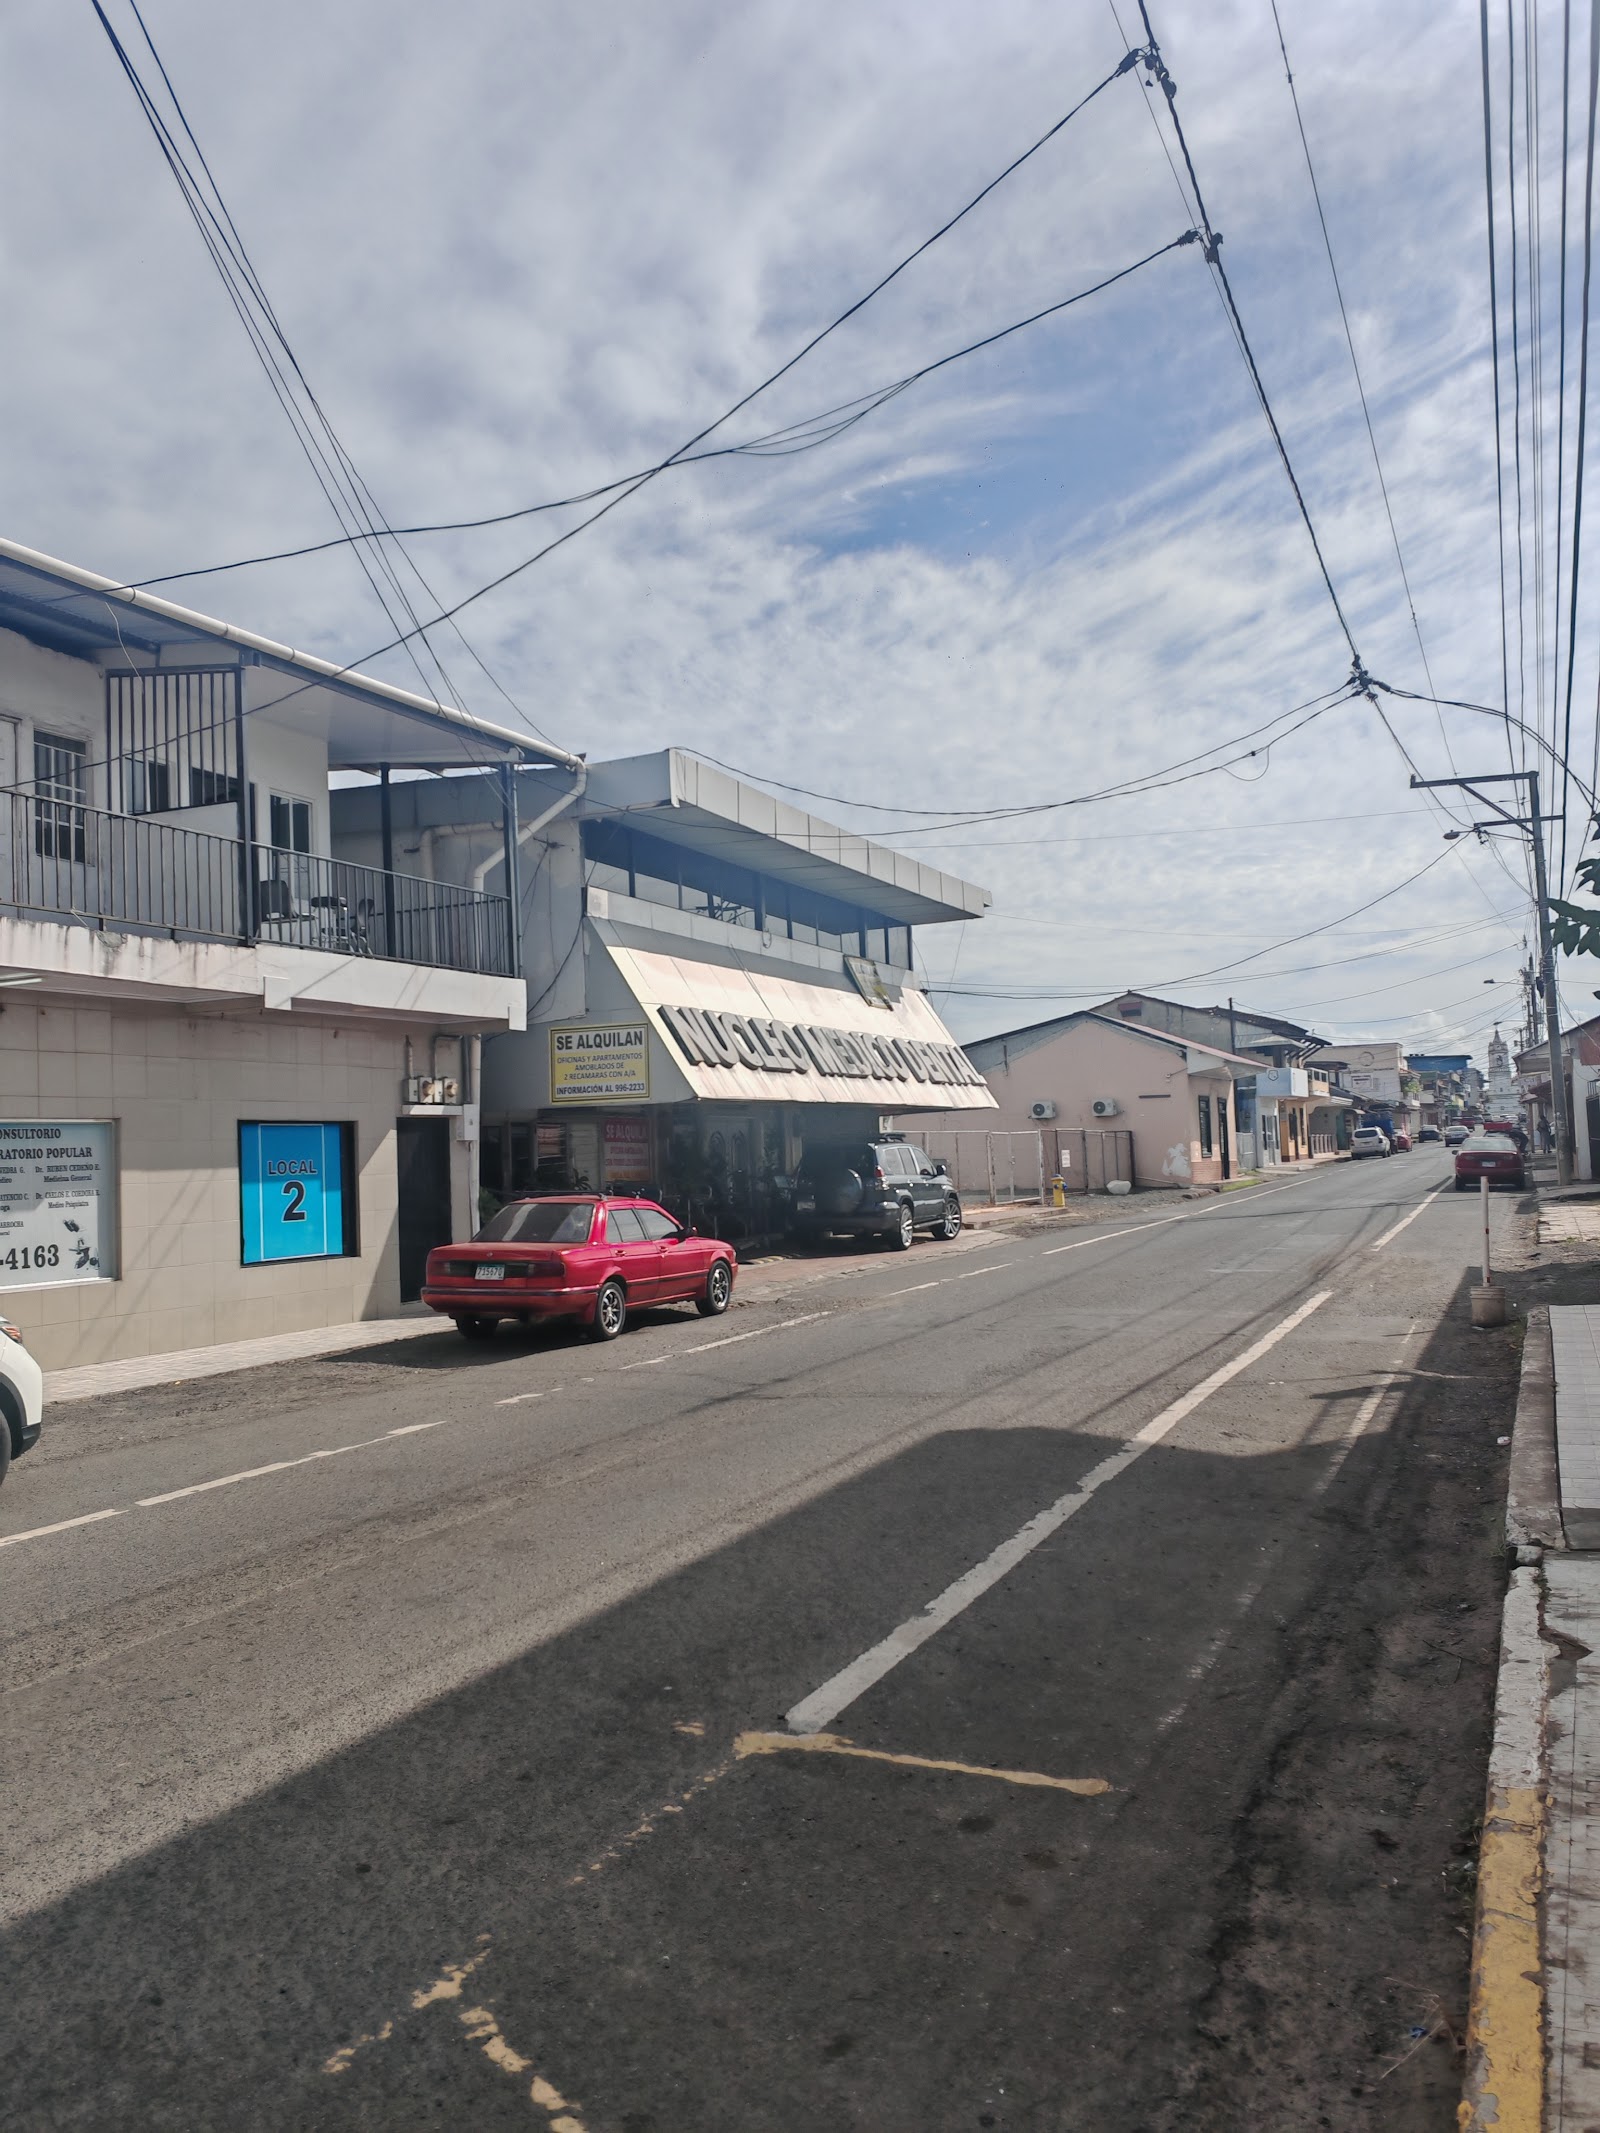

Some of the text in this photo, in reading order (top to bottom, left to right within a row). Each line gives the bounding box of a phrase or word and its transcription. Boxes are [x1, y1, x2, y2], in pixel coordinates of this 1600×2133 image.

[556, 1031, 643, 1050] SE ALQUILAN
[657, 1004, 988, 1086] NUCLEO MEDICO DENTAL
[592, 1052, 643, 1062] APARTAMENTOS
[616, 1061, 624, 1069] DE
[556, 1084, 603, 1095] INFORMACIÓN
[604, 1084, 613, 1093] AL
[46, 1147, 93, 1158] POPULAR
[267, 1159, 318, 1176] LOCAL
[281, 1180, 307, 1223] 2
